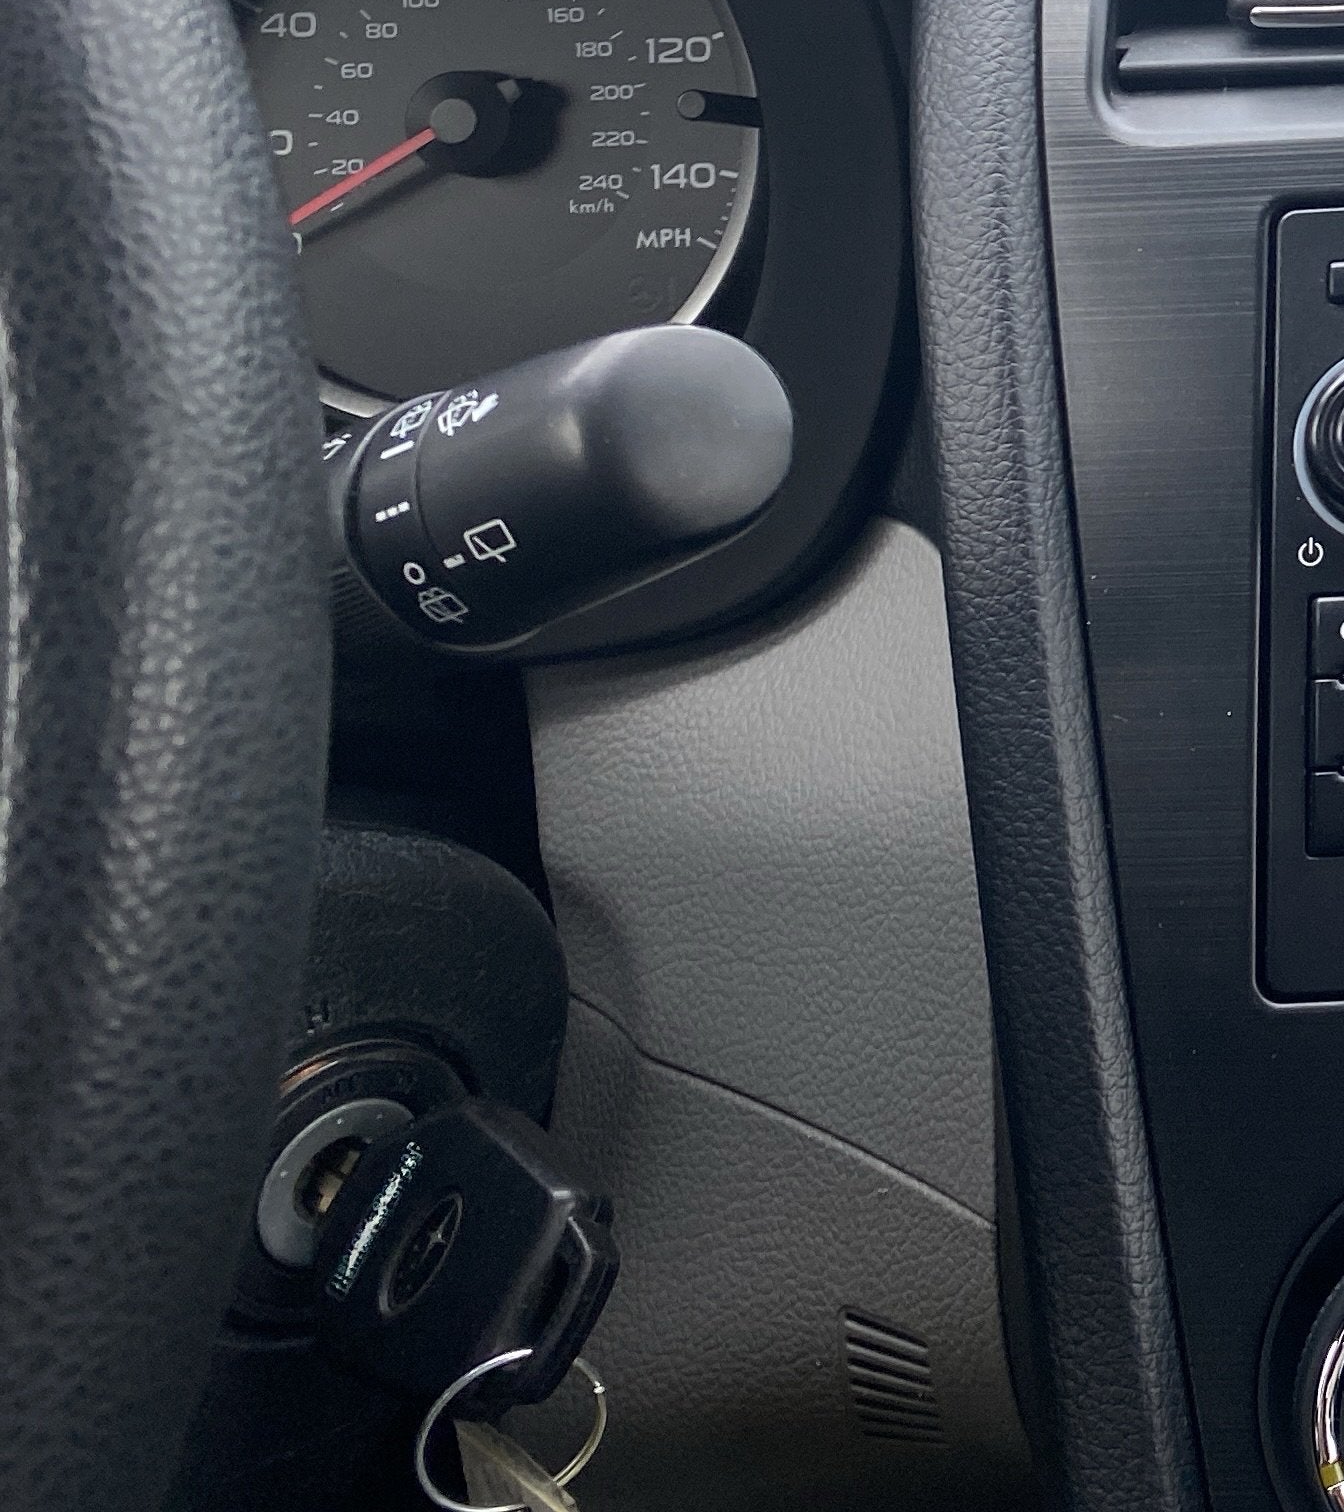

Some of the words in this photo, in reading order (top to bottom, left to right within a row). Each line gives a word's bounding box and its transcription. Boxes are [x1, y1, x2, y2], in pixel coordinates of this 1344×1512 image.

[547, 7, 585, 24] 160
[260, 11, 317, 38] 40
[365, 22, 398, 39] 80
[575, 40, 613, 58] 180
[645, 37, 713, 64] 120
[340, 62, 374, 79] 60
[589, 84, 635, 101] 200
[325, 109, 360, 126] 40
[591, 130, 635, 148] 220
[332, 158, 364, 175] 20
[578, 173, 623, 191] 240
[650, 162, 716, 190] 140
[569, 198, 615, 215] km/h
[635, 229, 692, 250] MPH
